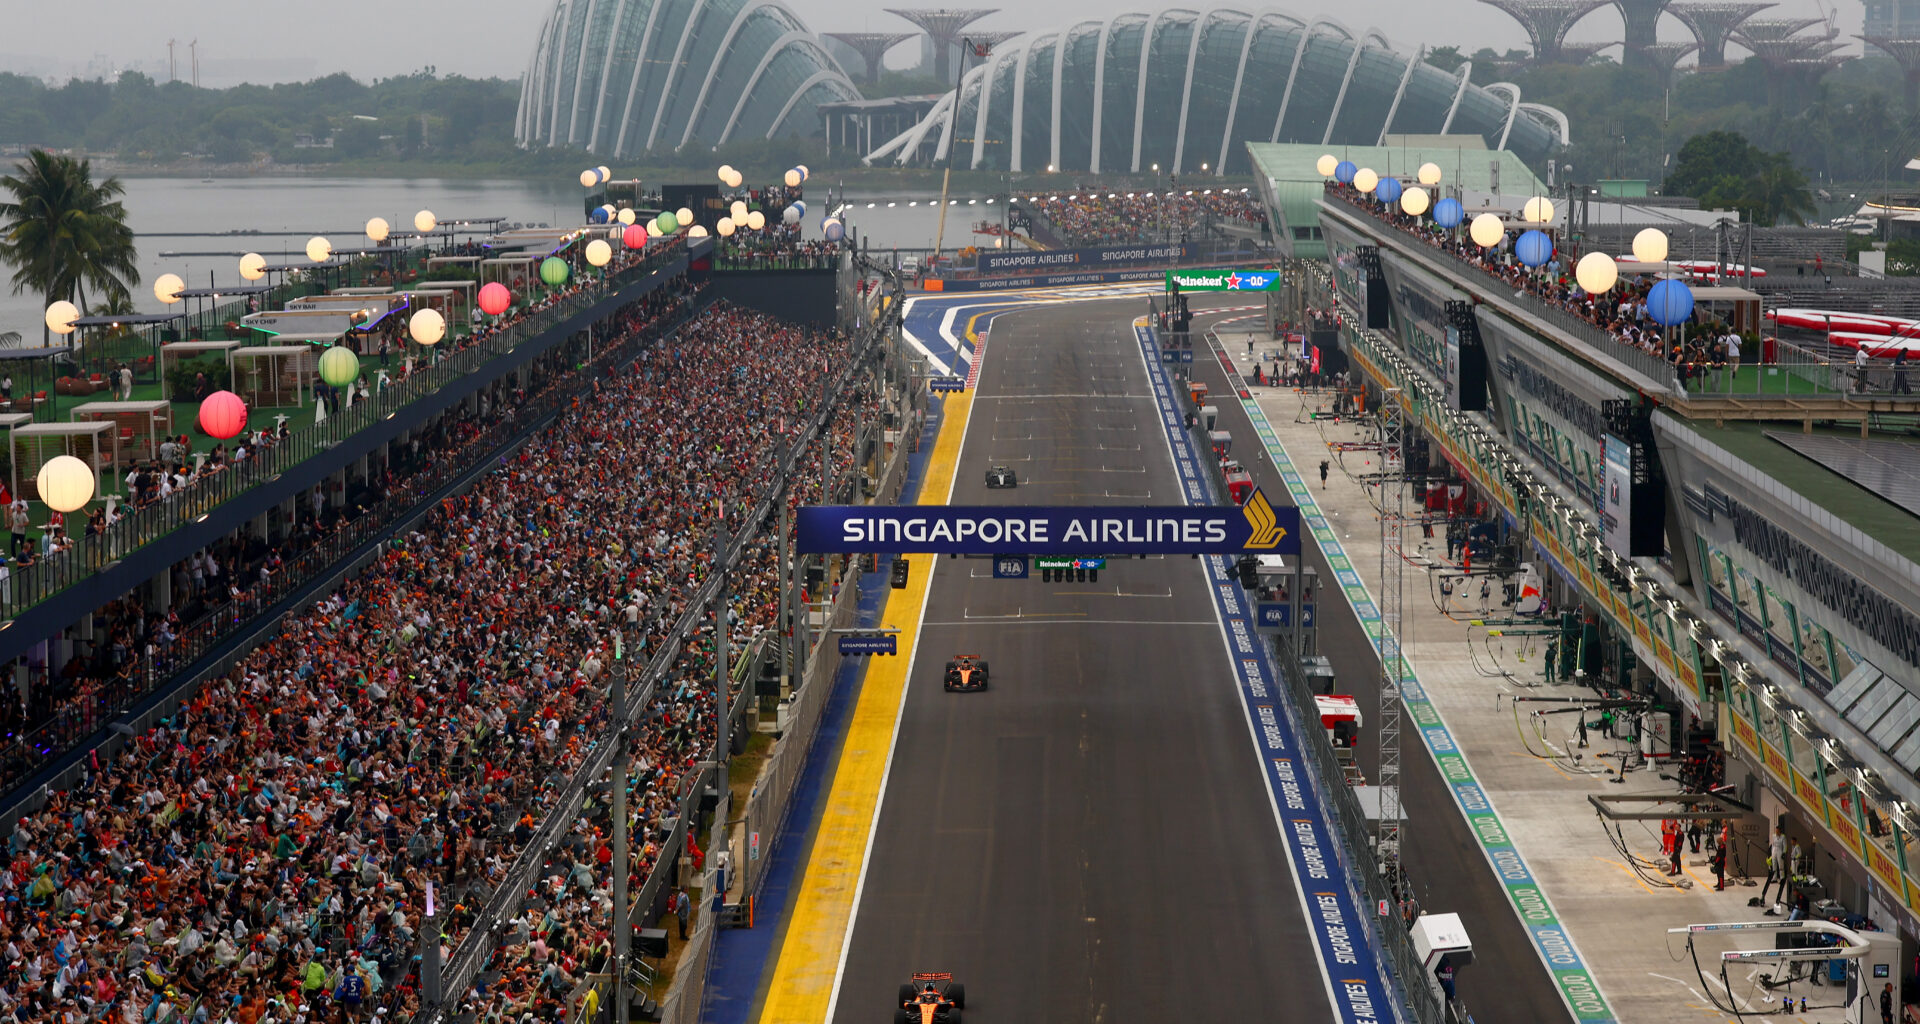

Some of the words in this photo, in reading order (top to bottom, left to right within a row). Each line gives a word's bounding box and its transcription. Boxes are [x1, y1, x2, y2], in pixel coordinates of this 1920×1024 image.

[990, 256, 1036, 267] SINGAPORE
[1038, 254, 1073, 264] AIRLINES
[1102, 250, 1145, 261] SINGAPORE
[1147, 248, 1181, 258] AIRLINES
[844, 518, 1049, 543] SINGAPORE
[1062, 518, 1226, 543] AIRLINES
[1317, 895, 1345, 925] AIRLINES
[1514, 888, 1550, 920] aramco
[1327, 926, 1358, 965] SINGAPORE
[1537, 930, 1576, 964] aramco
[350, 981, 357, 992] 5
[1562, 975, 1604, 1013] aramco
